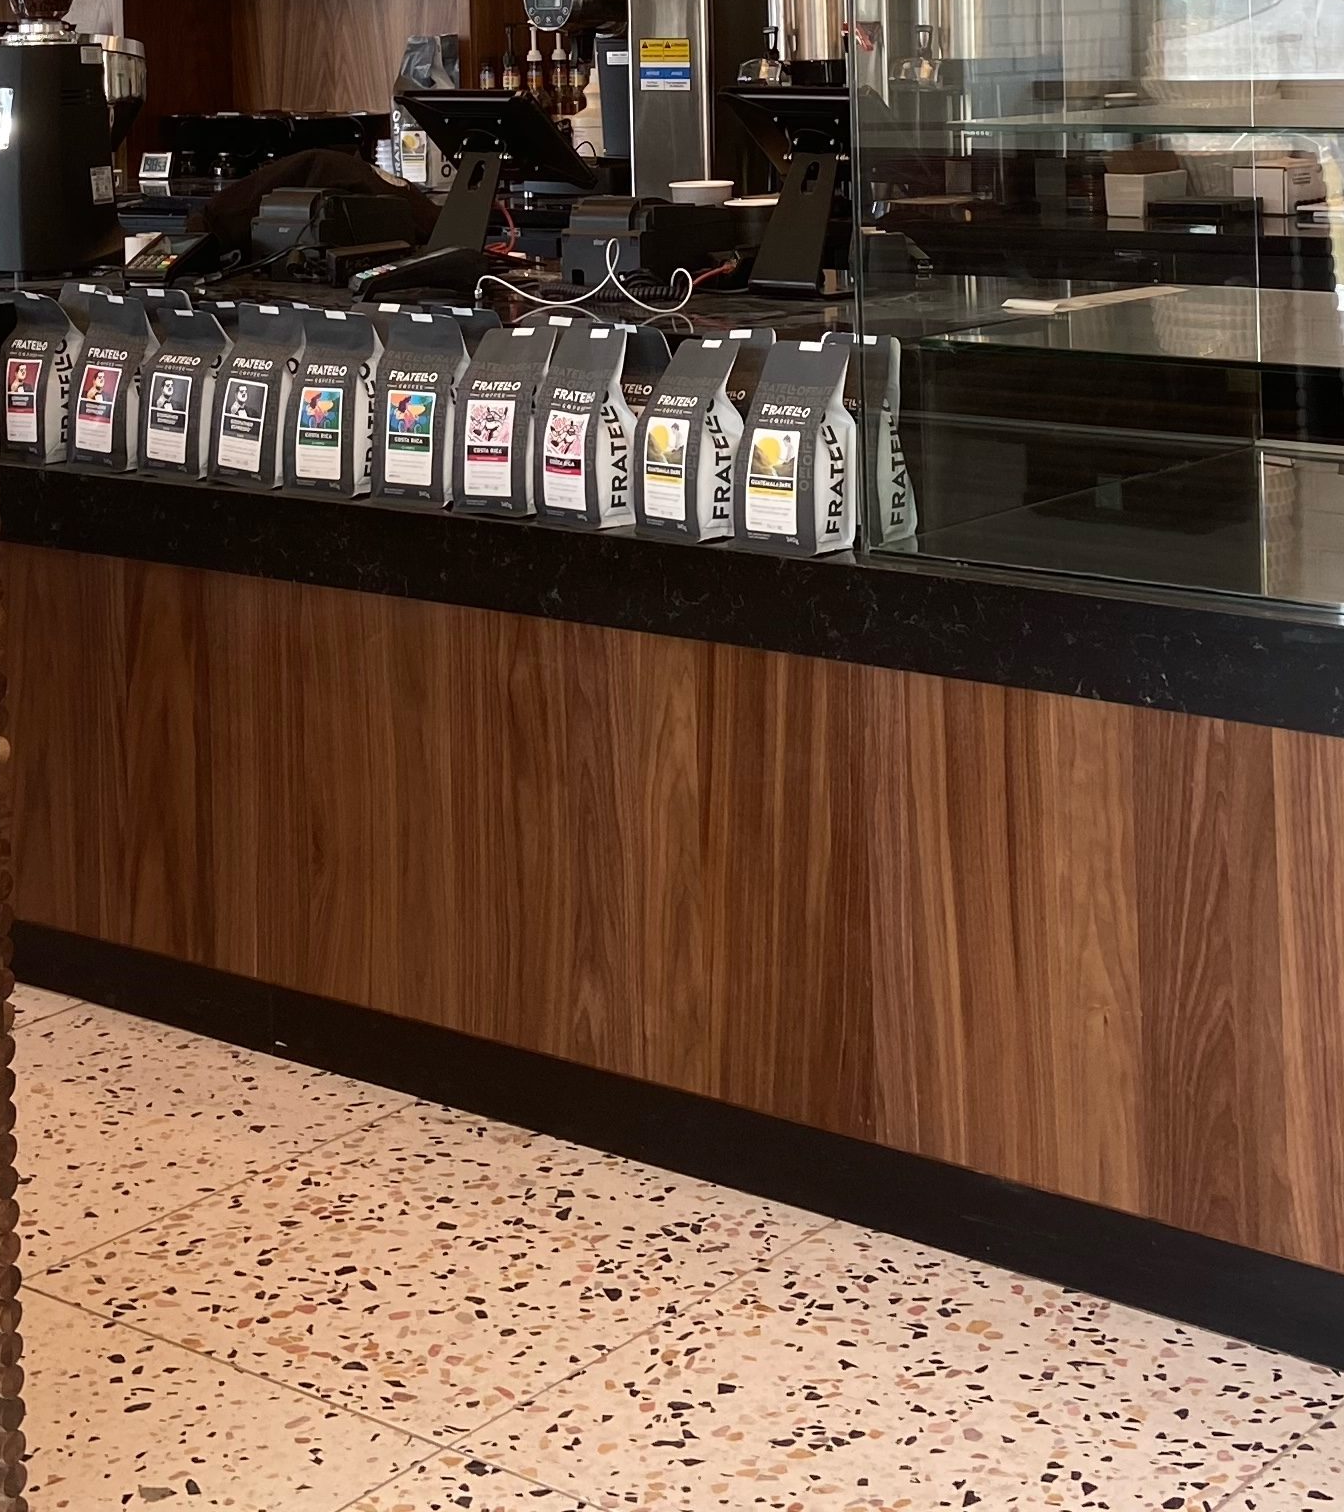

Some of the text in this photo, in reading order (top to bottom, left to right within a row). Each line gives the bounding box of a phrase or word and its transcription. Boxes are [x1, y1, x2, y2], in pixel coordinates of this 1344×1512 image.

[11, 339, 48, 351] FRATELLO
[87, 347, 128, 361] FRATELLO
[159, 354, 201, 366] FRATELLO
[232, 357, 274, 371] FRATELLO
[306, 364, 348, 376] FRATELLO
[388, 370, 438, 383] FRATELLO
[471, 380, 522, 391] FRATELLO
[620, 383, 653, 395] TELLO
[657, 394, 698, 407] FRATELLO
[761, 403, 811, 419] FRATELLO
[820, 413, 844, 534] FRATEL
